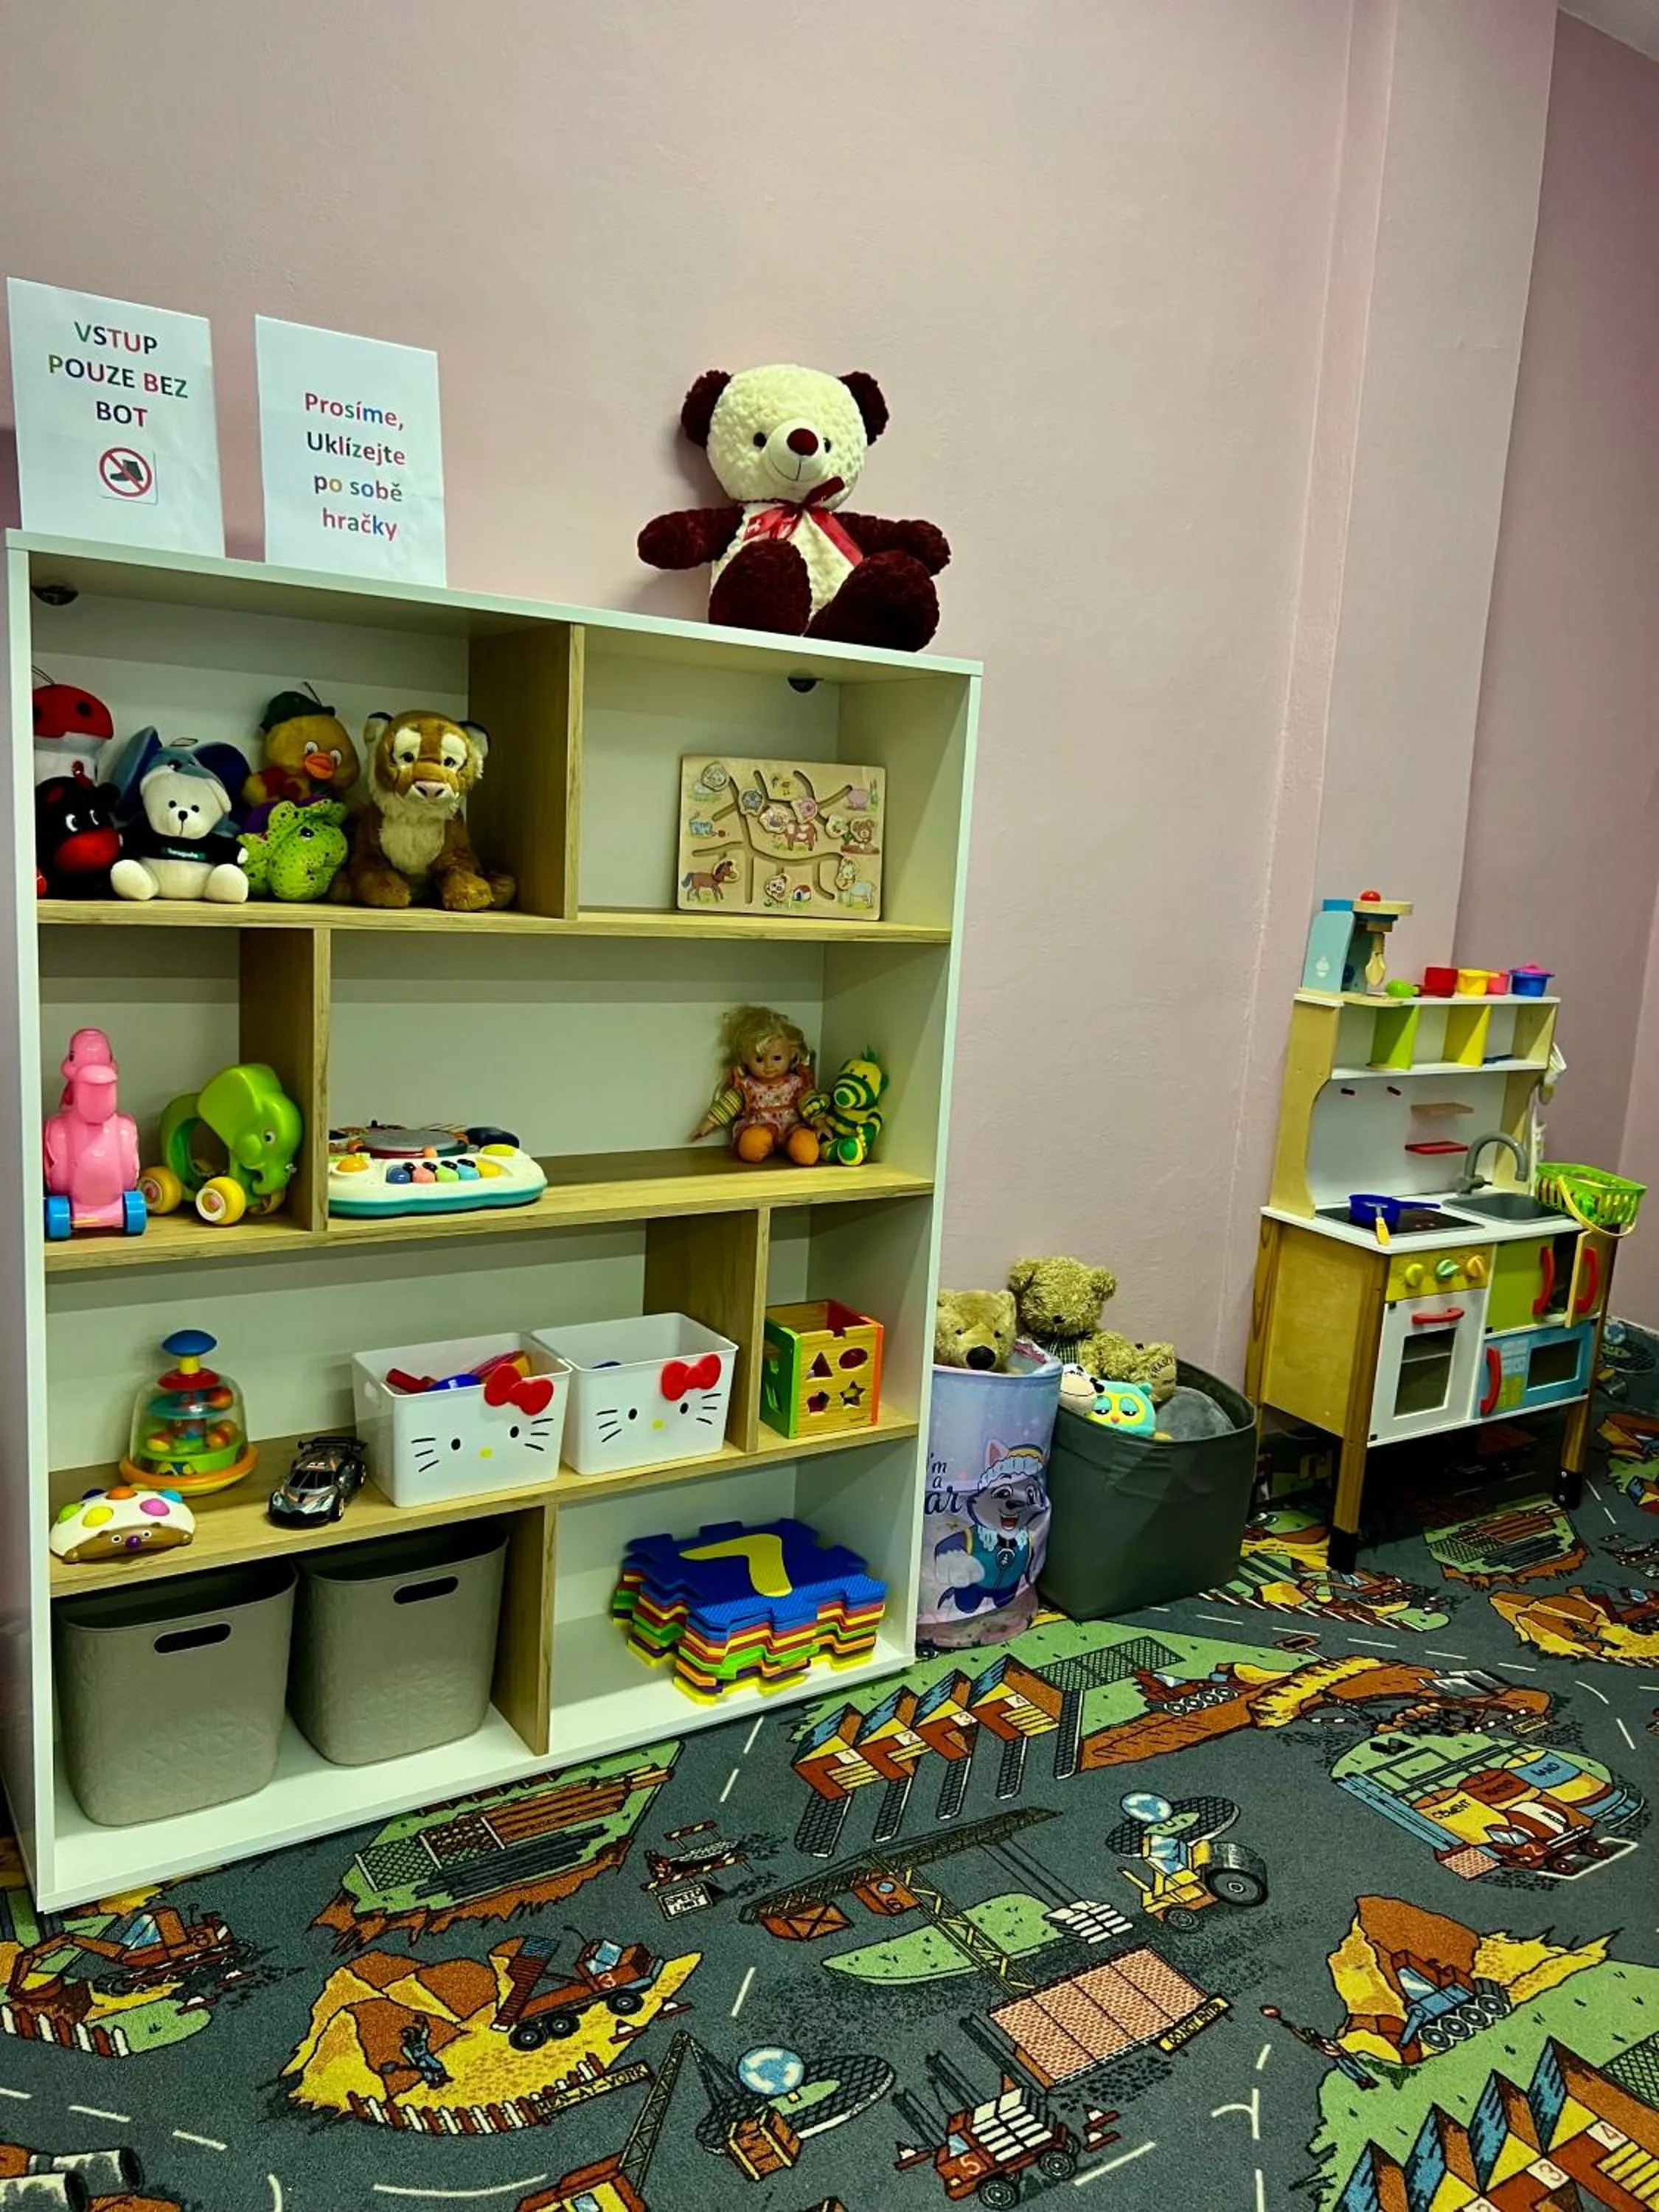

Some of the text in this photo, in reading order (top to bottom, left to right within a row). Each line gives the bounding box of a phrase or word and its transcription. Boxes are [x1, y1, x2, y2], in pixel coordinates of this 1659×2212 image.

[74, 321, 158, 355] VSTUP
[48, 355, 189, 399] POUZE BEZ
[96, 400, 147, 427] BOT
[305, 392, 405, 431] Prosíme,
[306, 431, 406, 465] Uklízejte
[314, 473, 403, 502] po sobě
[322, 509, 398, 541] hračky
[932, 1476, 942, 1489] a
[959, 2152, 981, 2175] 5
[1538, 2162, 1563, 2183] 3
